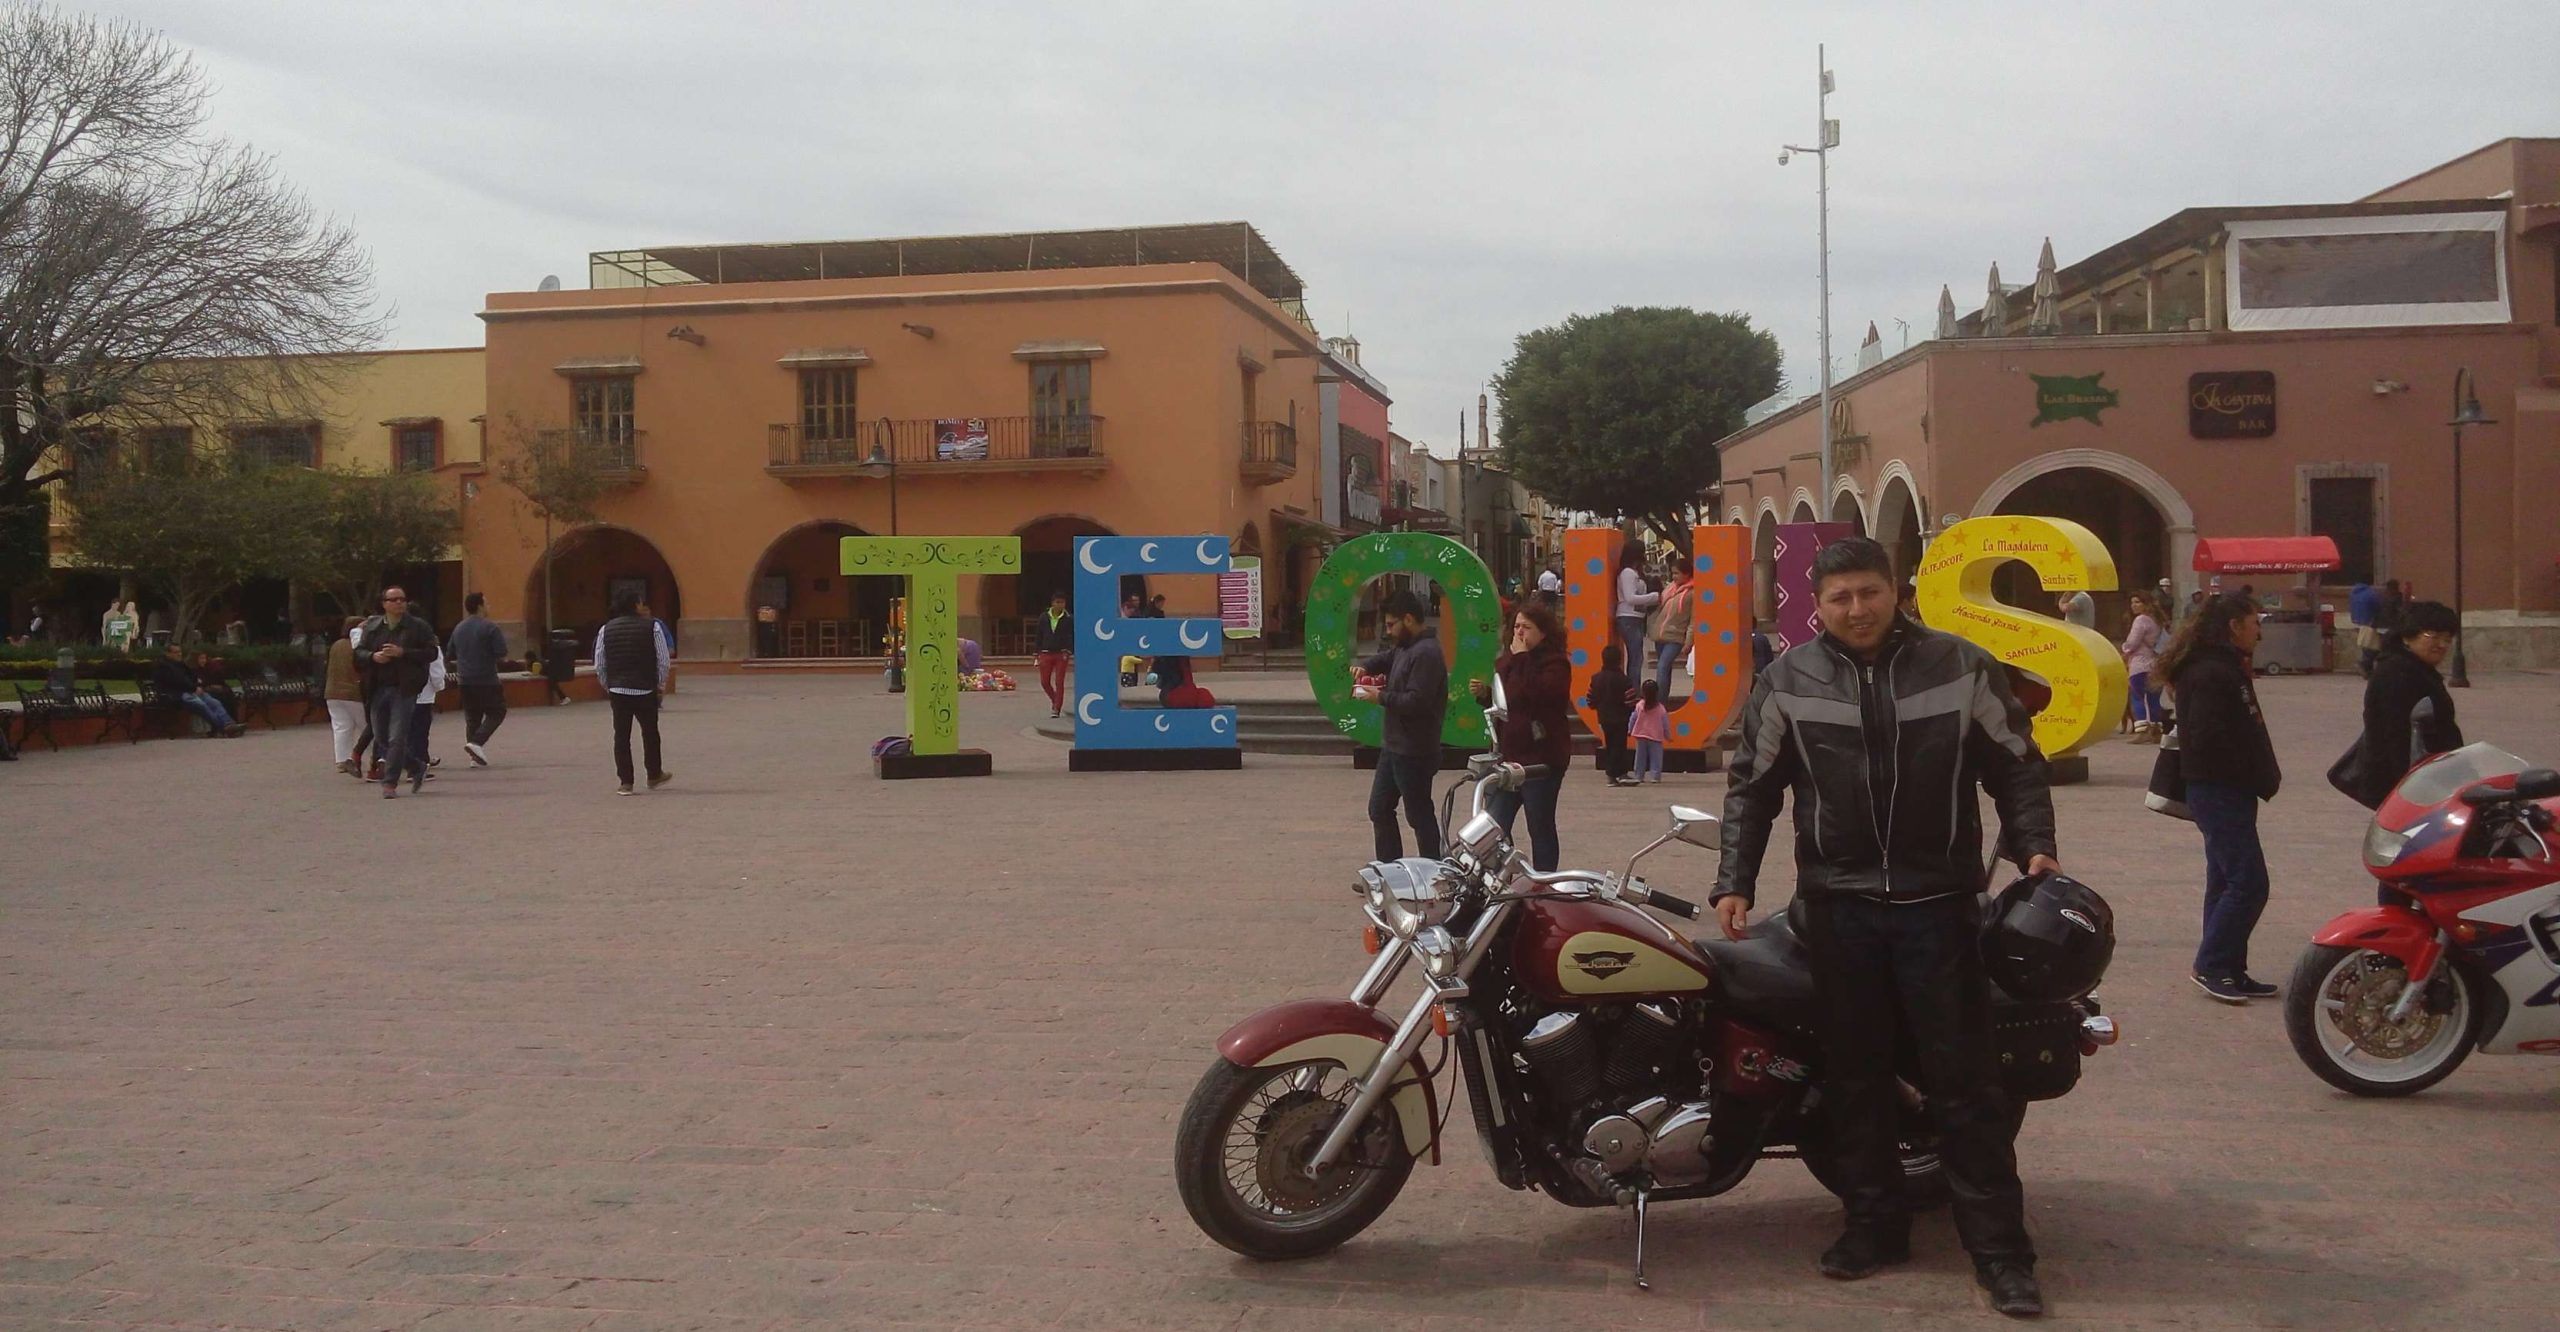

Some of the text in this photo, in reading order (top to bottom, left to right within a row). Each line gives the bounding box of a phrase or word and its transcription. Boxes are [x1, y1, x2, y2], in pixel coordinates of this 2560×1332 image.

[2239, 419, 2267, 430] BAR
[1982, 538, 2049, 554] La Magdalena
[1929, 552, 1964, 574] TEJOCOTE
[2042, 573, 2066, 585] Santa
[1951, 605, 1991, 624] Hacienda
[2005, 641, 2058, 660] SANTILLAN
